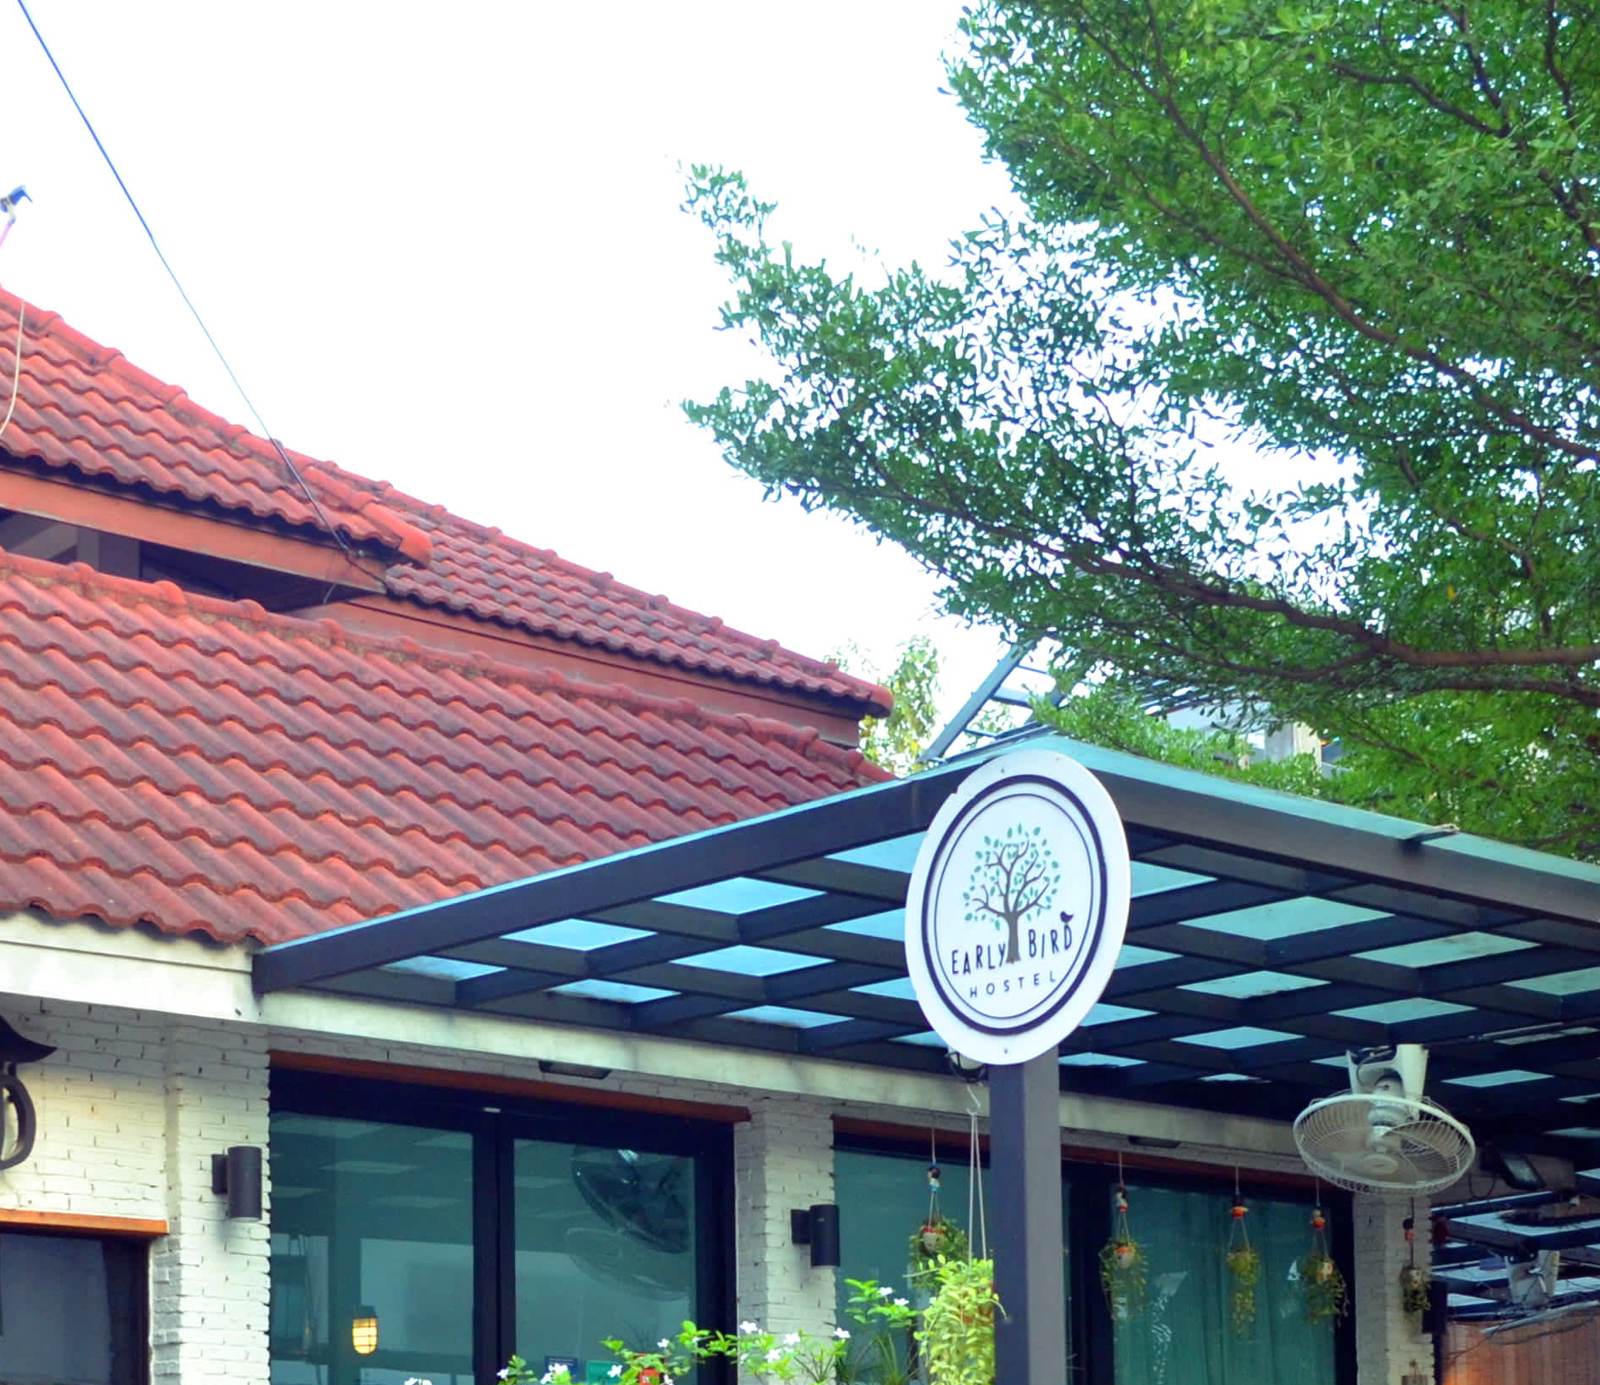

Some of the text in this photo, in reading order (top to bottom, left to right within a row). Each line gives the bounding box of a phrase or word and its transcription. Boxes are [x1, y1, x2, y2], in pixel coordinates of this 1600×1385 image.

[951, 924, 1073, 975] EARLY BIRD
[970, 970, 1056, 998] HOSTEL
